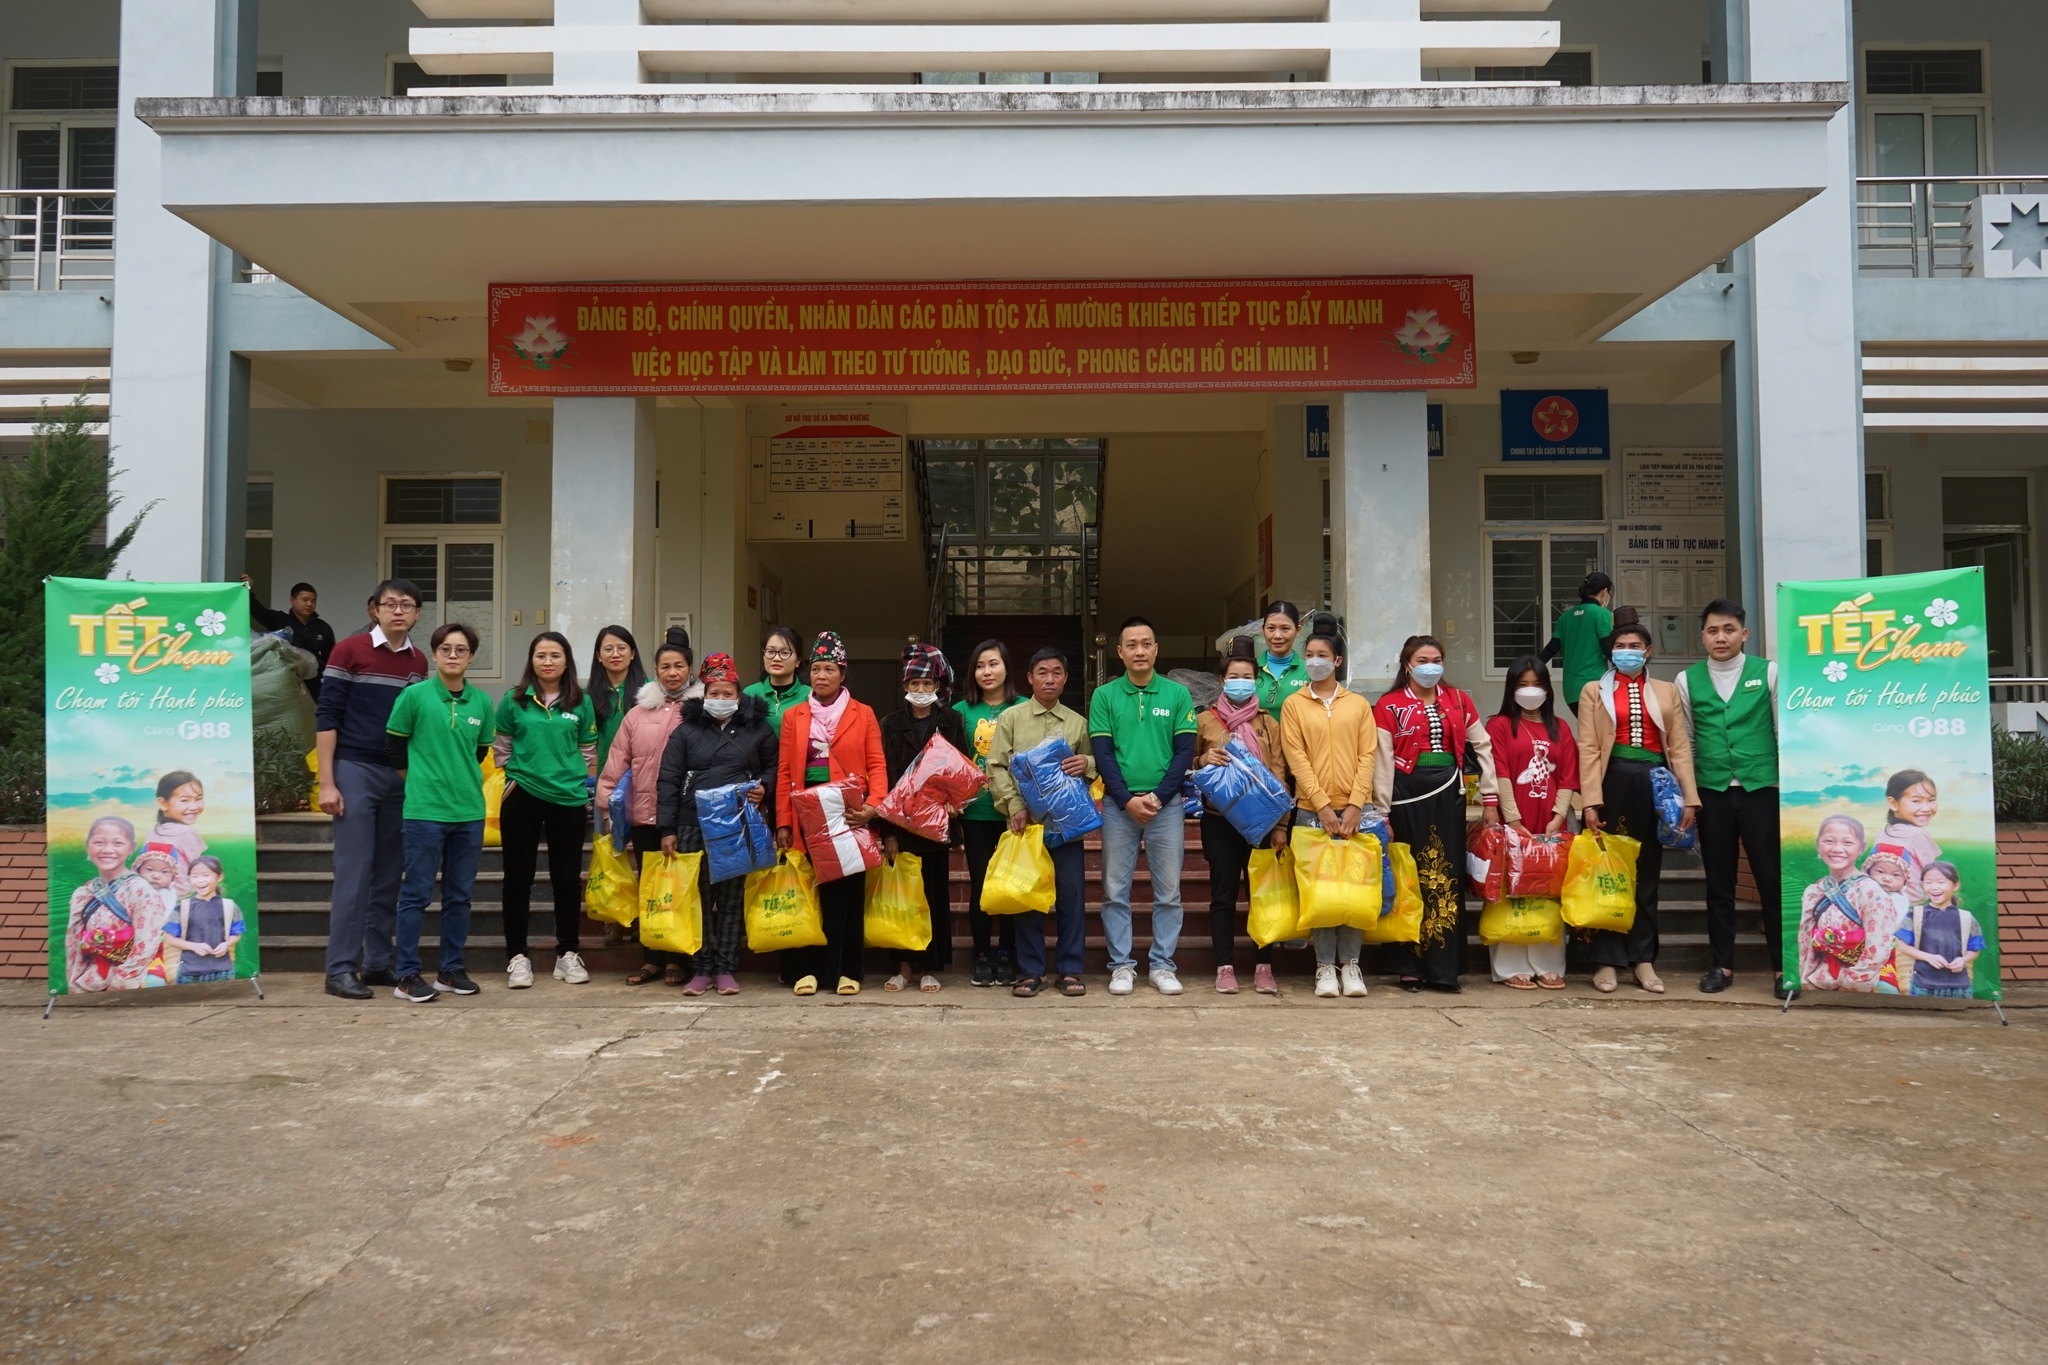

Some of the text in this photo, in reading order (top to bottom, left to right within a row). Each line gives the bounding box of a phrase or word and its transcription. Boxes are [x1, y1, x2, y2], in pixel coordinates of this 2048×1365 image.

[577, 290, 1383, 335] ĐẢNG BỘ, CHÍNH QUYỀN, NHÂN DÂN CÁC DÂN TỘC XÃ MƯỜNG KHIÊNG TIẾP TỤC ĐẨY MẠNH
[632, 346, 671, 382] VIỆC
[677, 350, 714, 381] HỌC
[719, 346, 753, 381] TẬP
[759, 345, 782, 376] VÀ
[787, 345, 826, 376] LÀM
[832, 350, 877, 375] THEO
[882, 348, 907, 375] TƯ
[910, 340, 970, 375] TƯỞNG
[986, 350, 1023, 380] ĐẠO
[1029, 343, 1071, 377] ĐỨC,
[1077, 348, 1140, 373] PHONG
[1145, 343, 1195, 373] CÁCH
[1200, 338, 1225, 372] HỒ
[1231, 342, 1261, 372] CHÍ
[1267, 347, 1317, 371] MINH
[1309, 428, 1319, 455] BỘ
[1629, 535, 1648, 549] BẢNG
[1650, 537, 1664, 549] TÊN
[1666, 534, 1680, 549] THỦ
[1683, 539, 1697, 551] TỤC
[1698, 537, 1718, 549] HÀNH
[69, 596, 168, 657] TẾT
[1798, 592, 1896, 656] TẾT
[128, 631, 234, 675] Chạm
[1855, 623, 1968, 671] Chạm
[55, 686, 108, 713] Chạm
[149, 686, 198, 713] Hạnh
[200, 688, 244, 717] phúc
[1152, 707, 1170, 717] F88
[1786, 686, 1836, 712] Chạm
[1877, 681, 1928, 710] Hạnh
[1932, 682, 1981, 713] phúc
[178, 720, 231, 741] F88
[1873, 716, 1967, 738] Cùng F88
